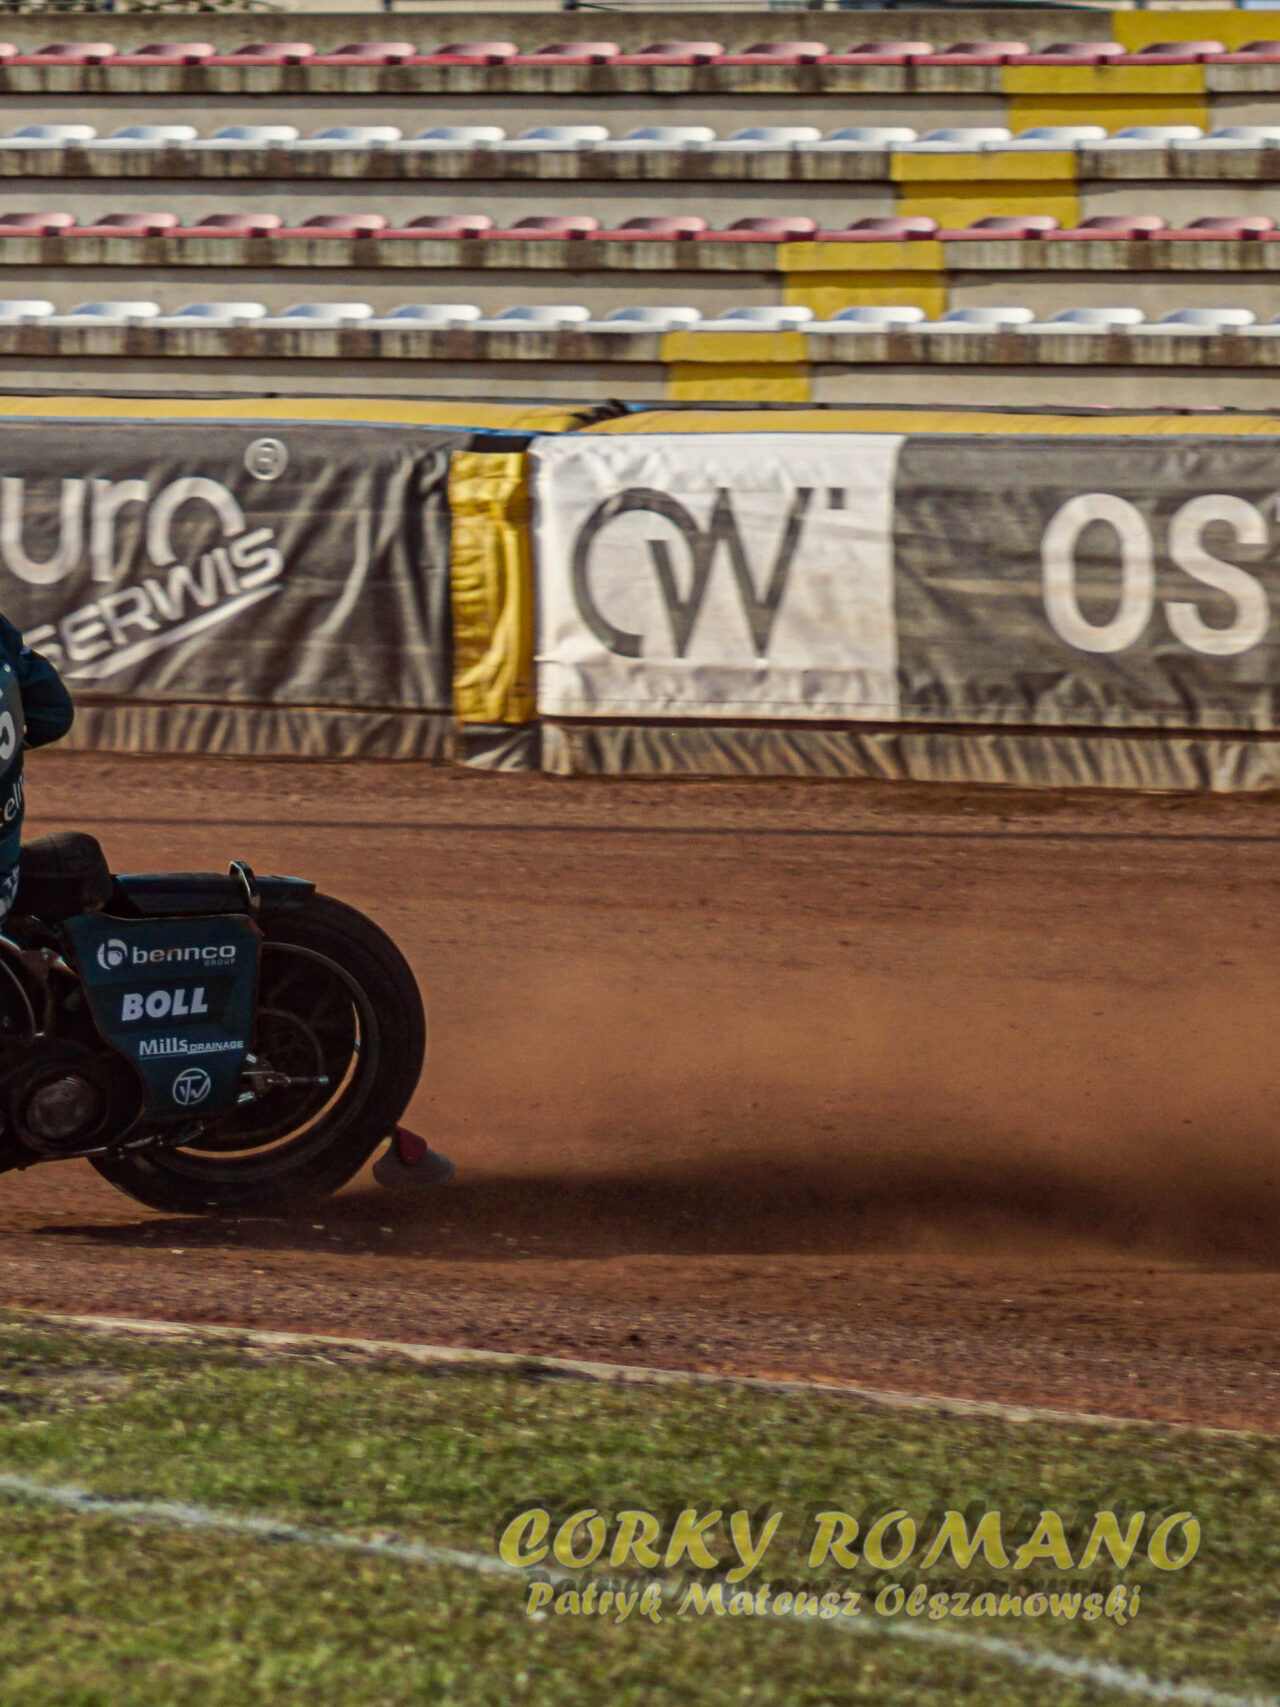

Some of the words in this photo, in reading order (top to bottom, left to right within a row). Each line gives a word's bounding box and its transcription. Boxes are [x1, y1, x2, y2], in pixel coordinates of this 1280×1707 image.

[1040, 493, 1280, 656] OS
[132, 944, 236, 965] bennco
[121, 986, 209, 1022] BOLL
[138, 1036, 188, 1056] Mills
[189, 1039, 244, 1053] DRAINAGE
